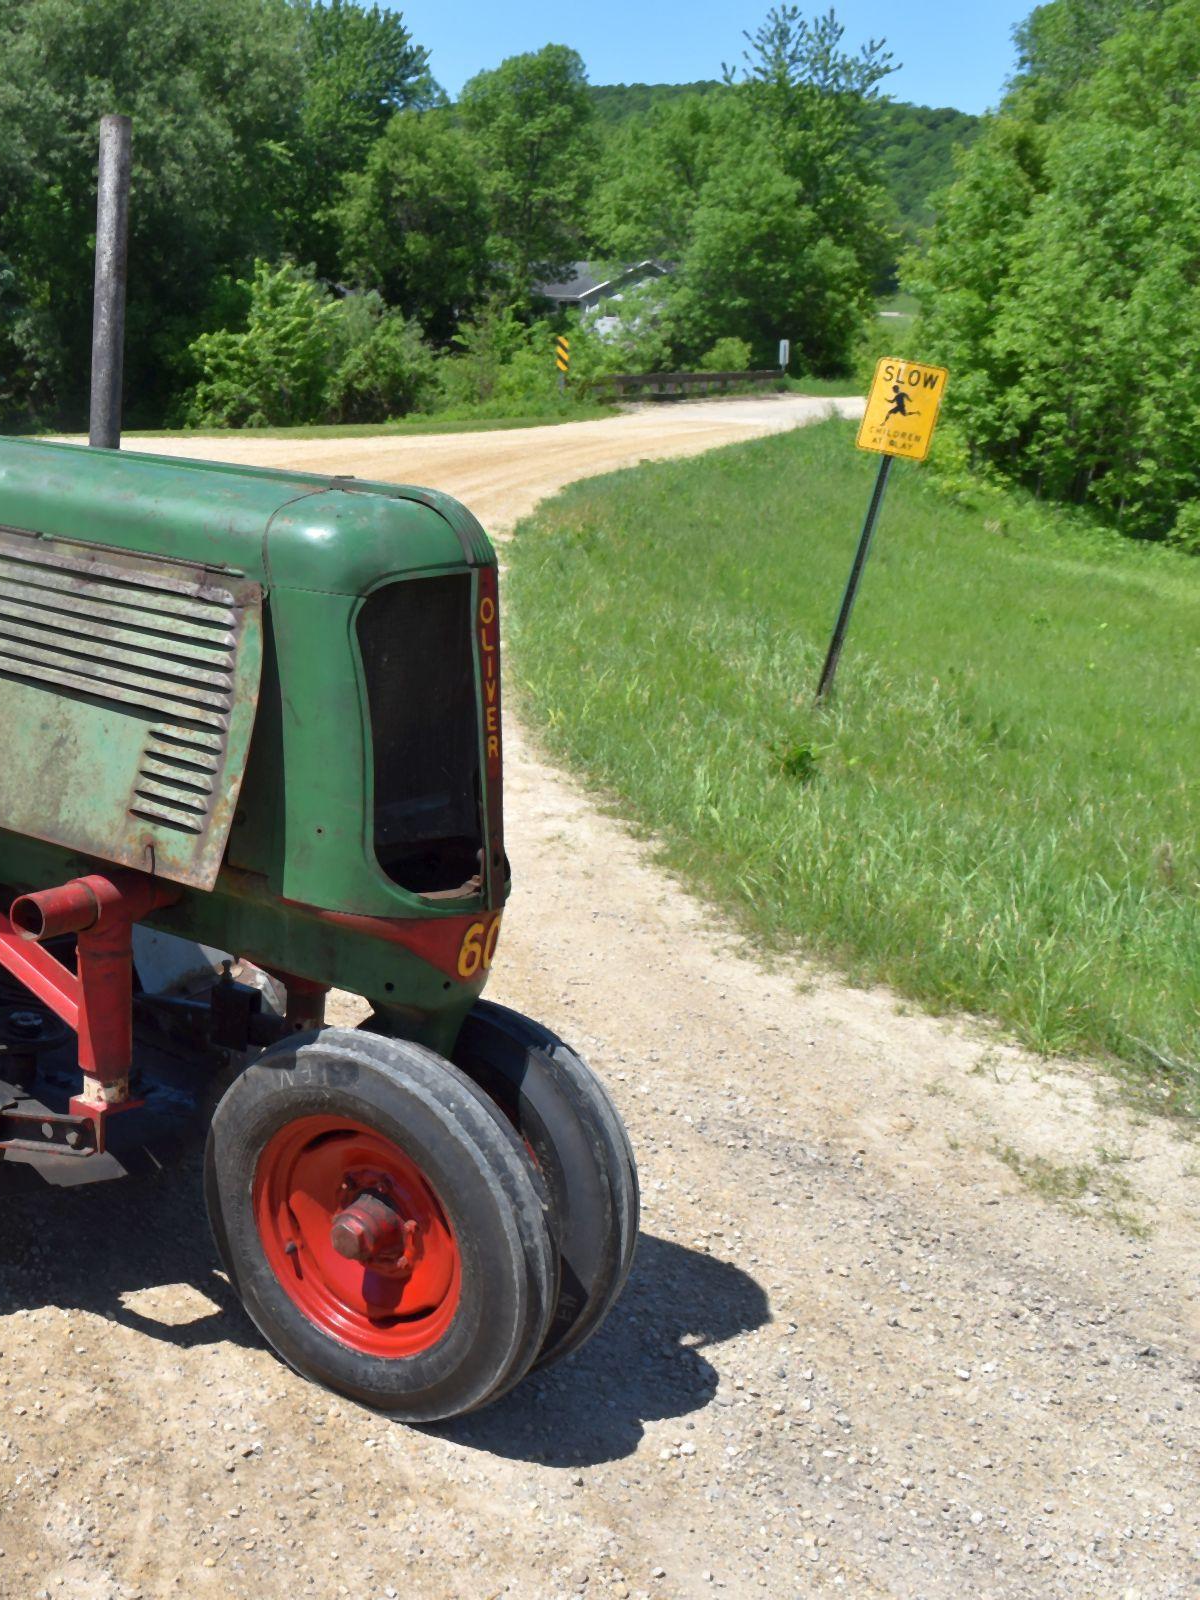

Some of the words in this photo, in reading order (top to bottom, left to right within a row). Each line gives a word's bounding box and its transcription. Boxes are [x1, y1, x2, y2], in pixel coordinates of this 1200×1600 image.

[883, 365, 939, 390] SLOW
[869, 426, 922, 442] CHILDREN
[479, 597, 499, 758] OLIVER
